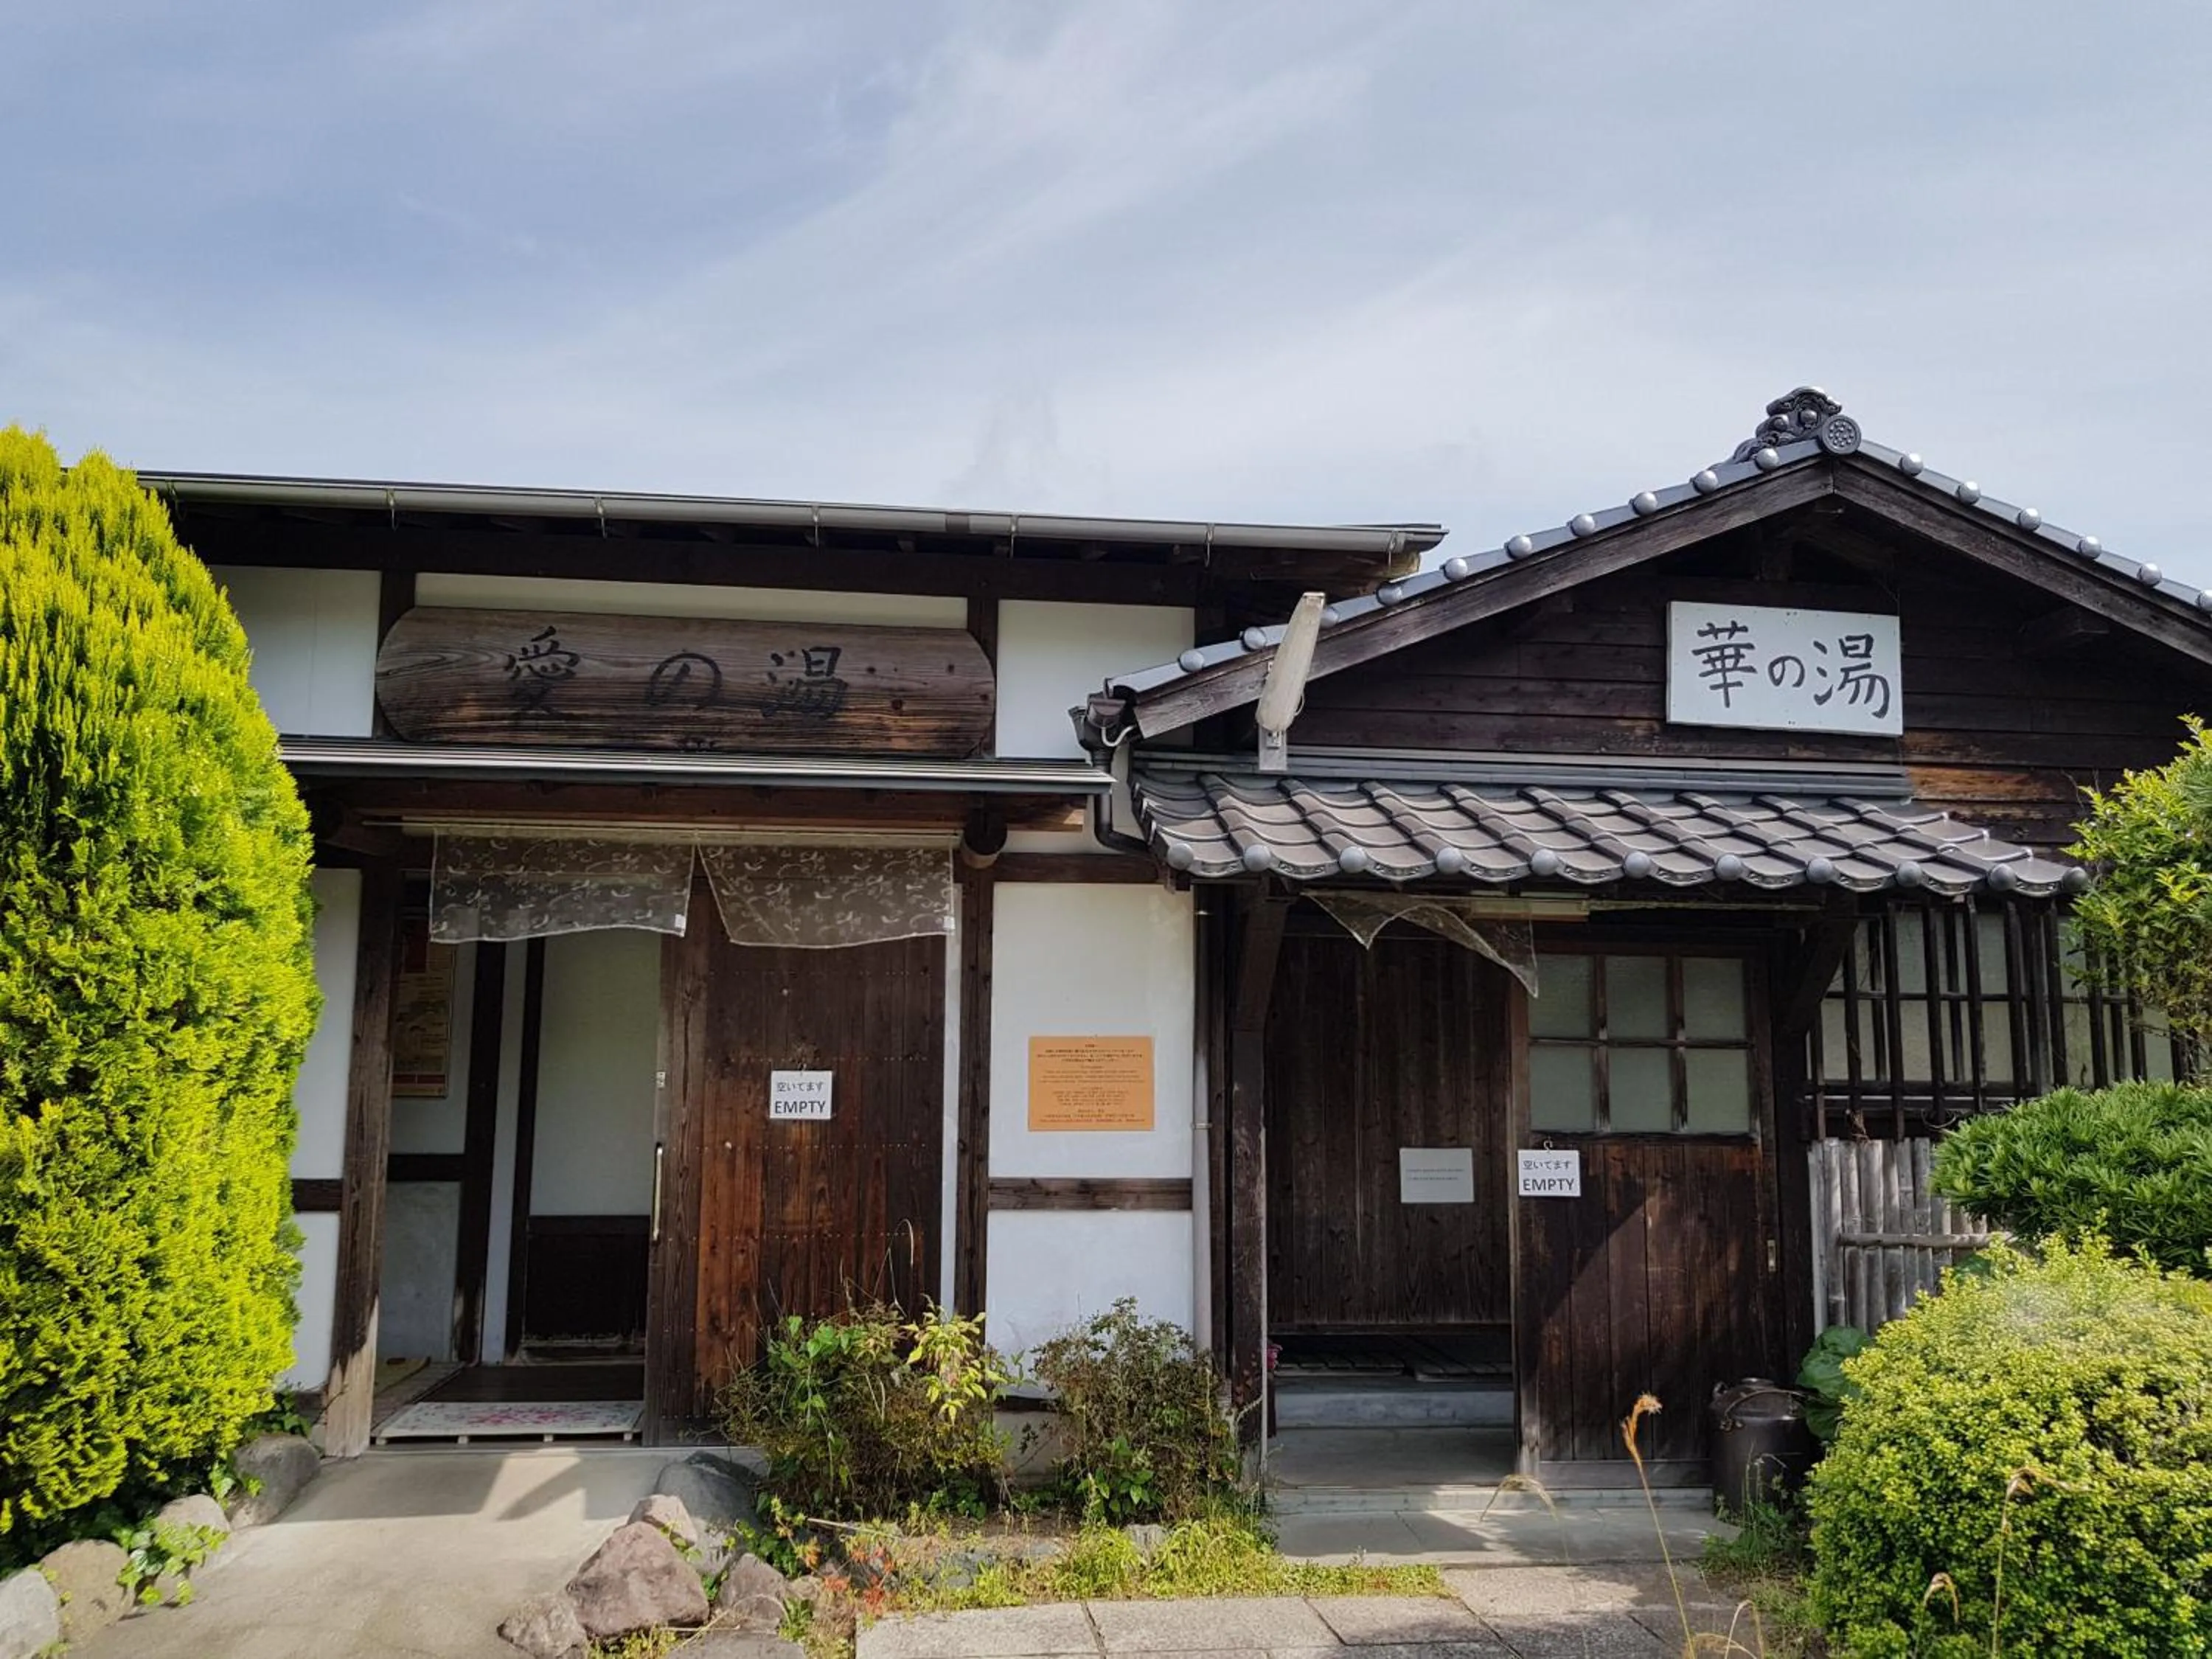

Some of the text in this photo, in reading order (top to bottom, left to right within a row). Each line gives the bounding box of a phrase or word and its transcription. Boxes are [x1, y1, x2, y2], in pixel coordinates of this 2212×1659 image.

[504, 625, 849, 720] 愛の湯
[1692, 621, 1890, 719] 華の湯
[776, 1081, 824, 1092] 空いてます
[774, 1100, 826, 1114] EMPTY
[1523, 1160, 1572, 1170] 空いてます
[1523, 1178, 1574, 1191] EMPTY
